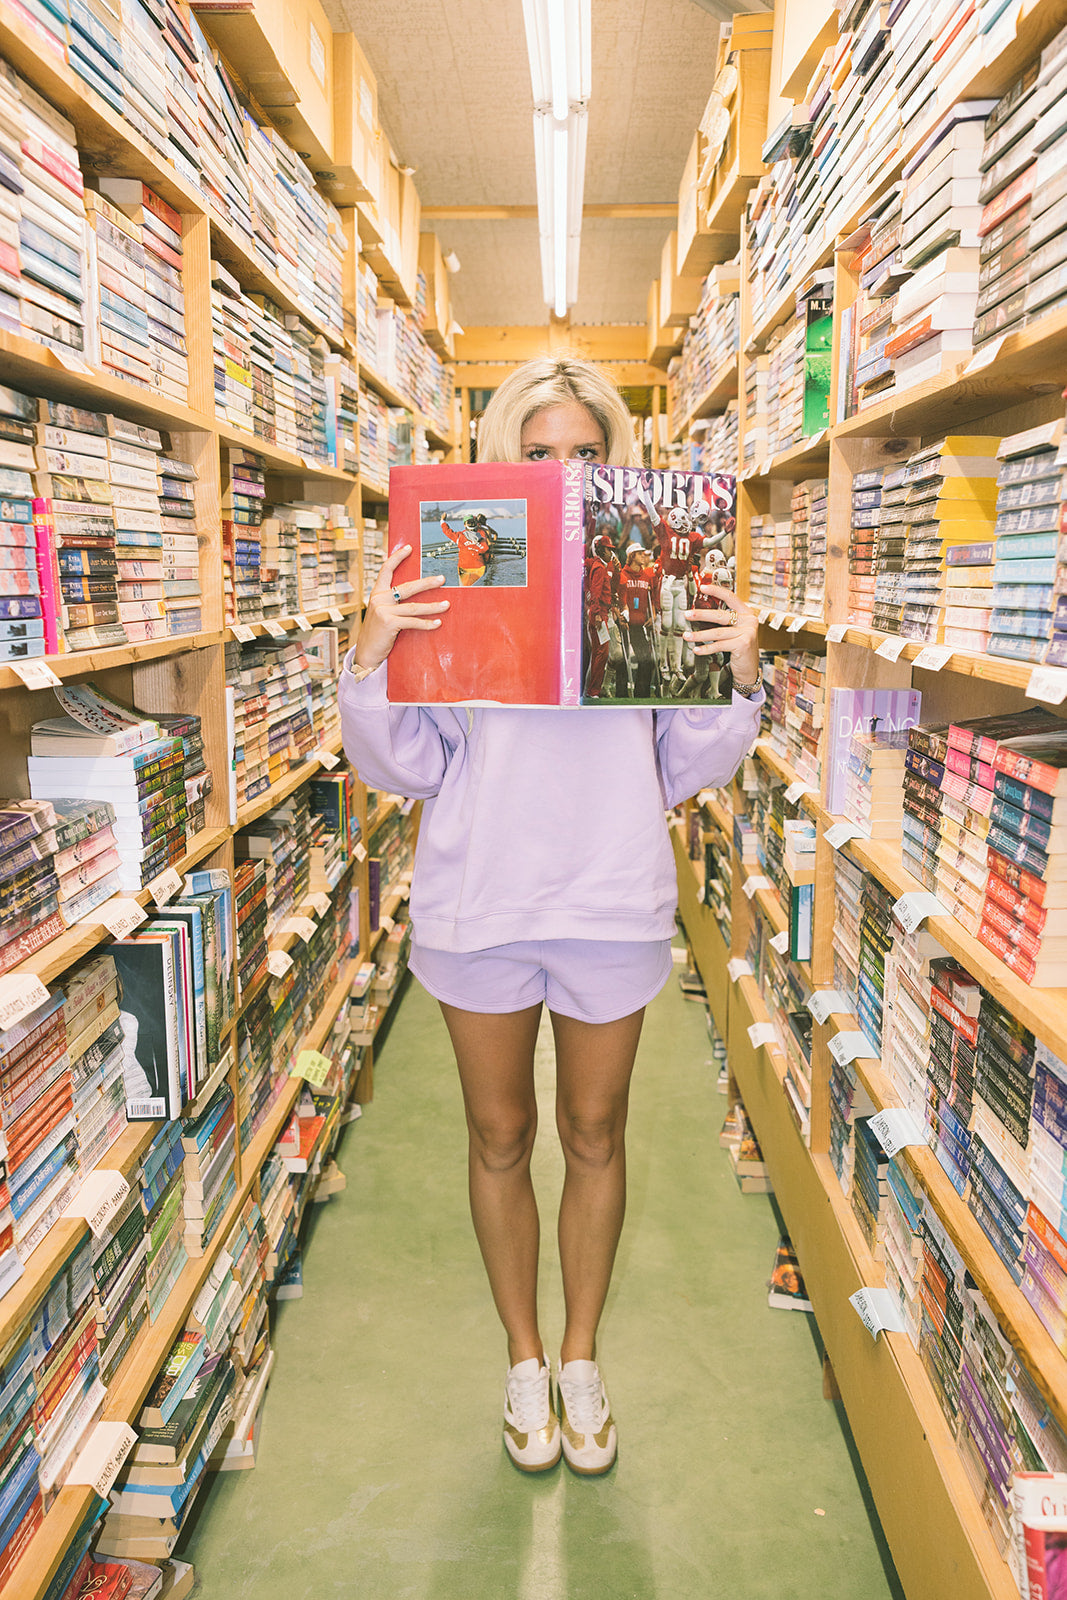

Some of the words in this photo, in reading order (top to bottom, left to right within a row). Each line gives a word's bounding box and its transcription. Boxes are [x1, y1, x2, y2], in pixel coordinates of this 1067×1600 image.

[585, 464, 593, 501] STANFORD
[593, 466, 733, 512] SPORTS
[564, 469, 582, 542] SPORTS
[670, 536, 690, 560] 10
